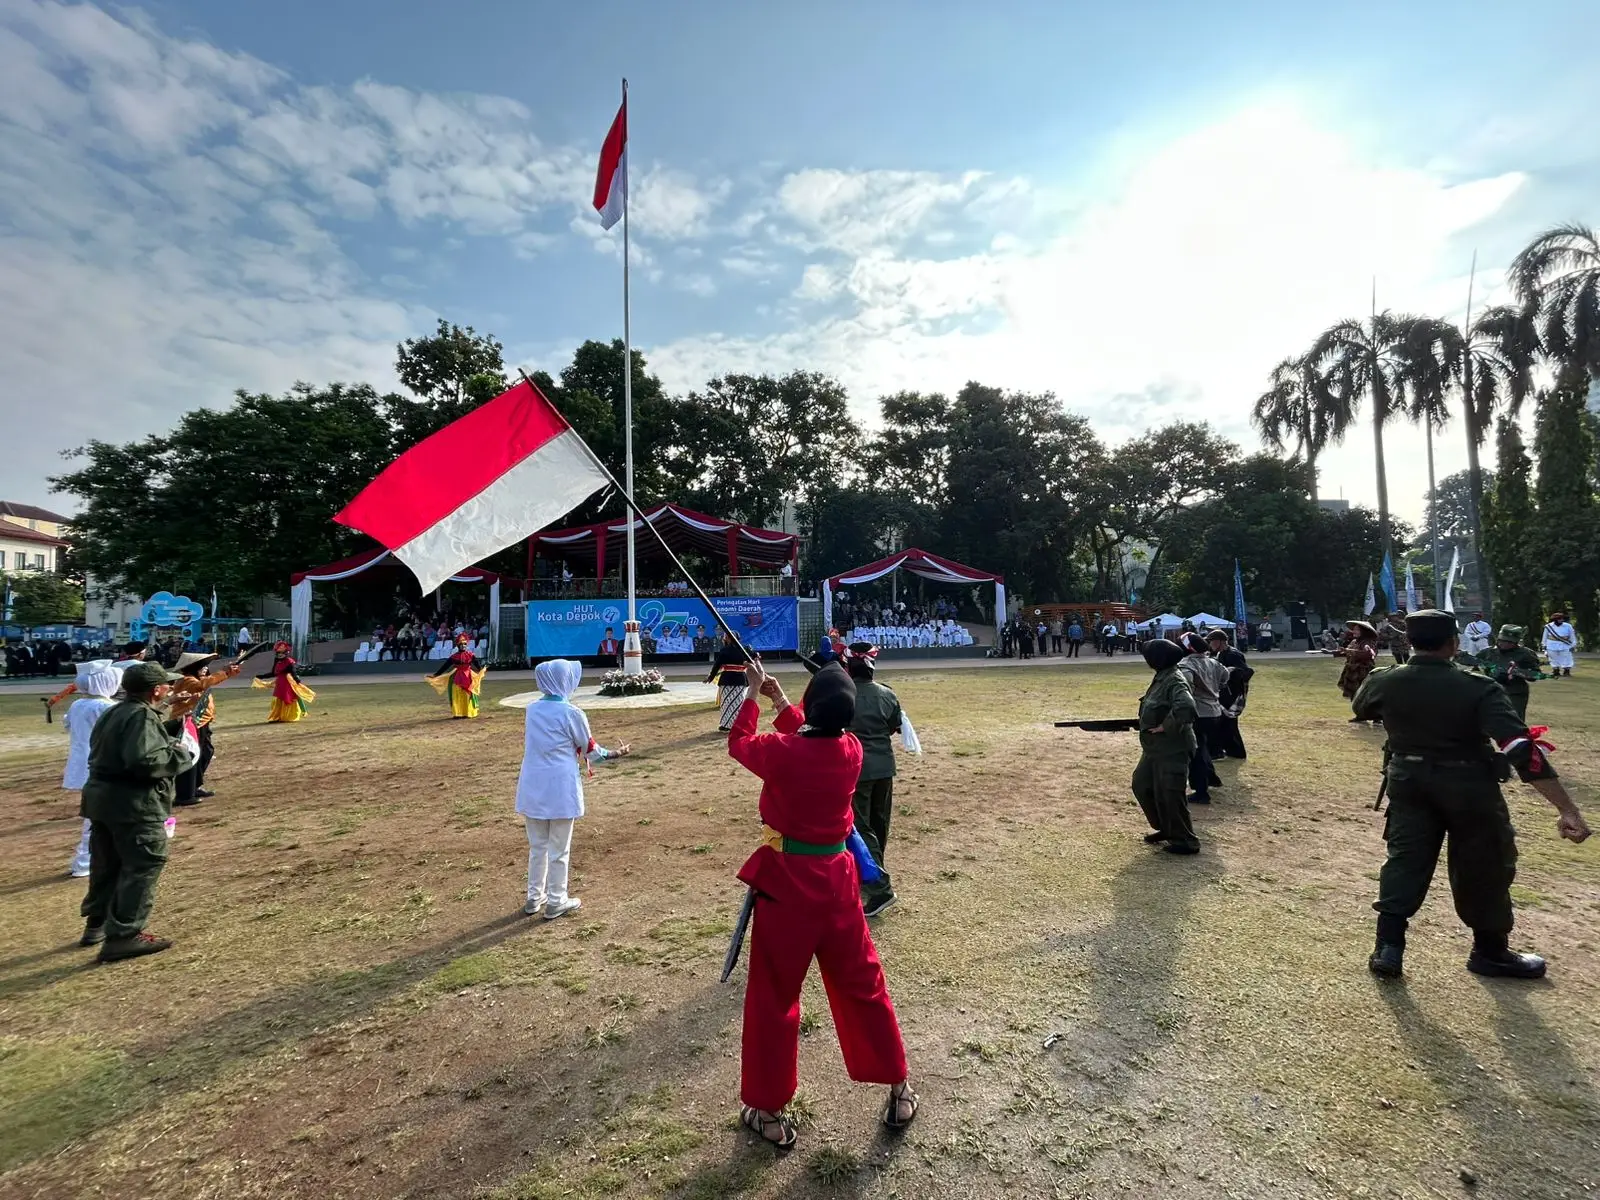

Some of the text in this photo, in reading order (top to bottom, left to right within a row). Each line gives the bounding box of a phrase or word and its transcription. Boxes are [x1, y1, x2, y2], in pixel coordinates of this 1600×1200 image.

[573, 604, 594, 613] HUT
[537, 611, 601, 622] Kota Depok
[605, 608, 616, 621] 27
